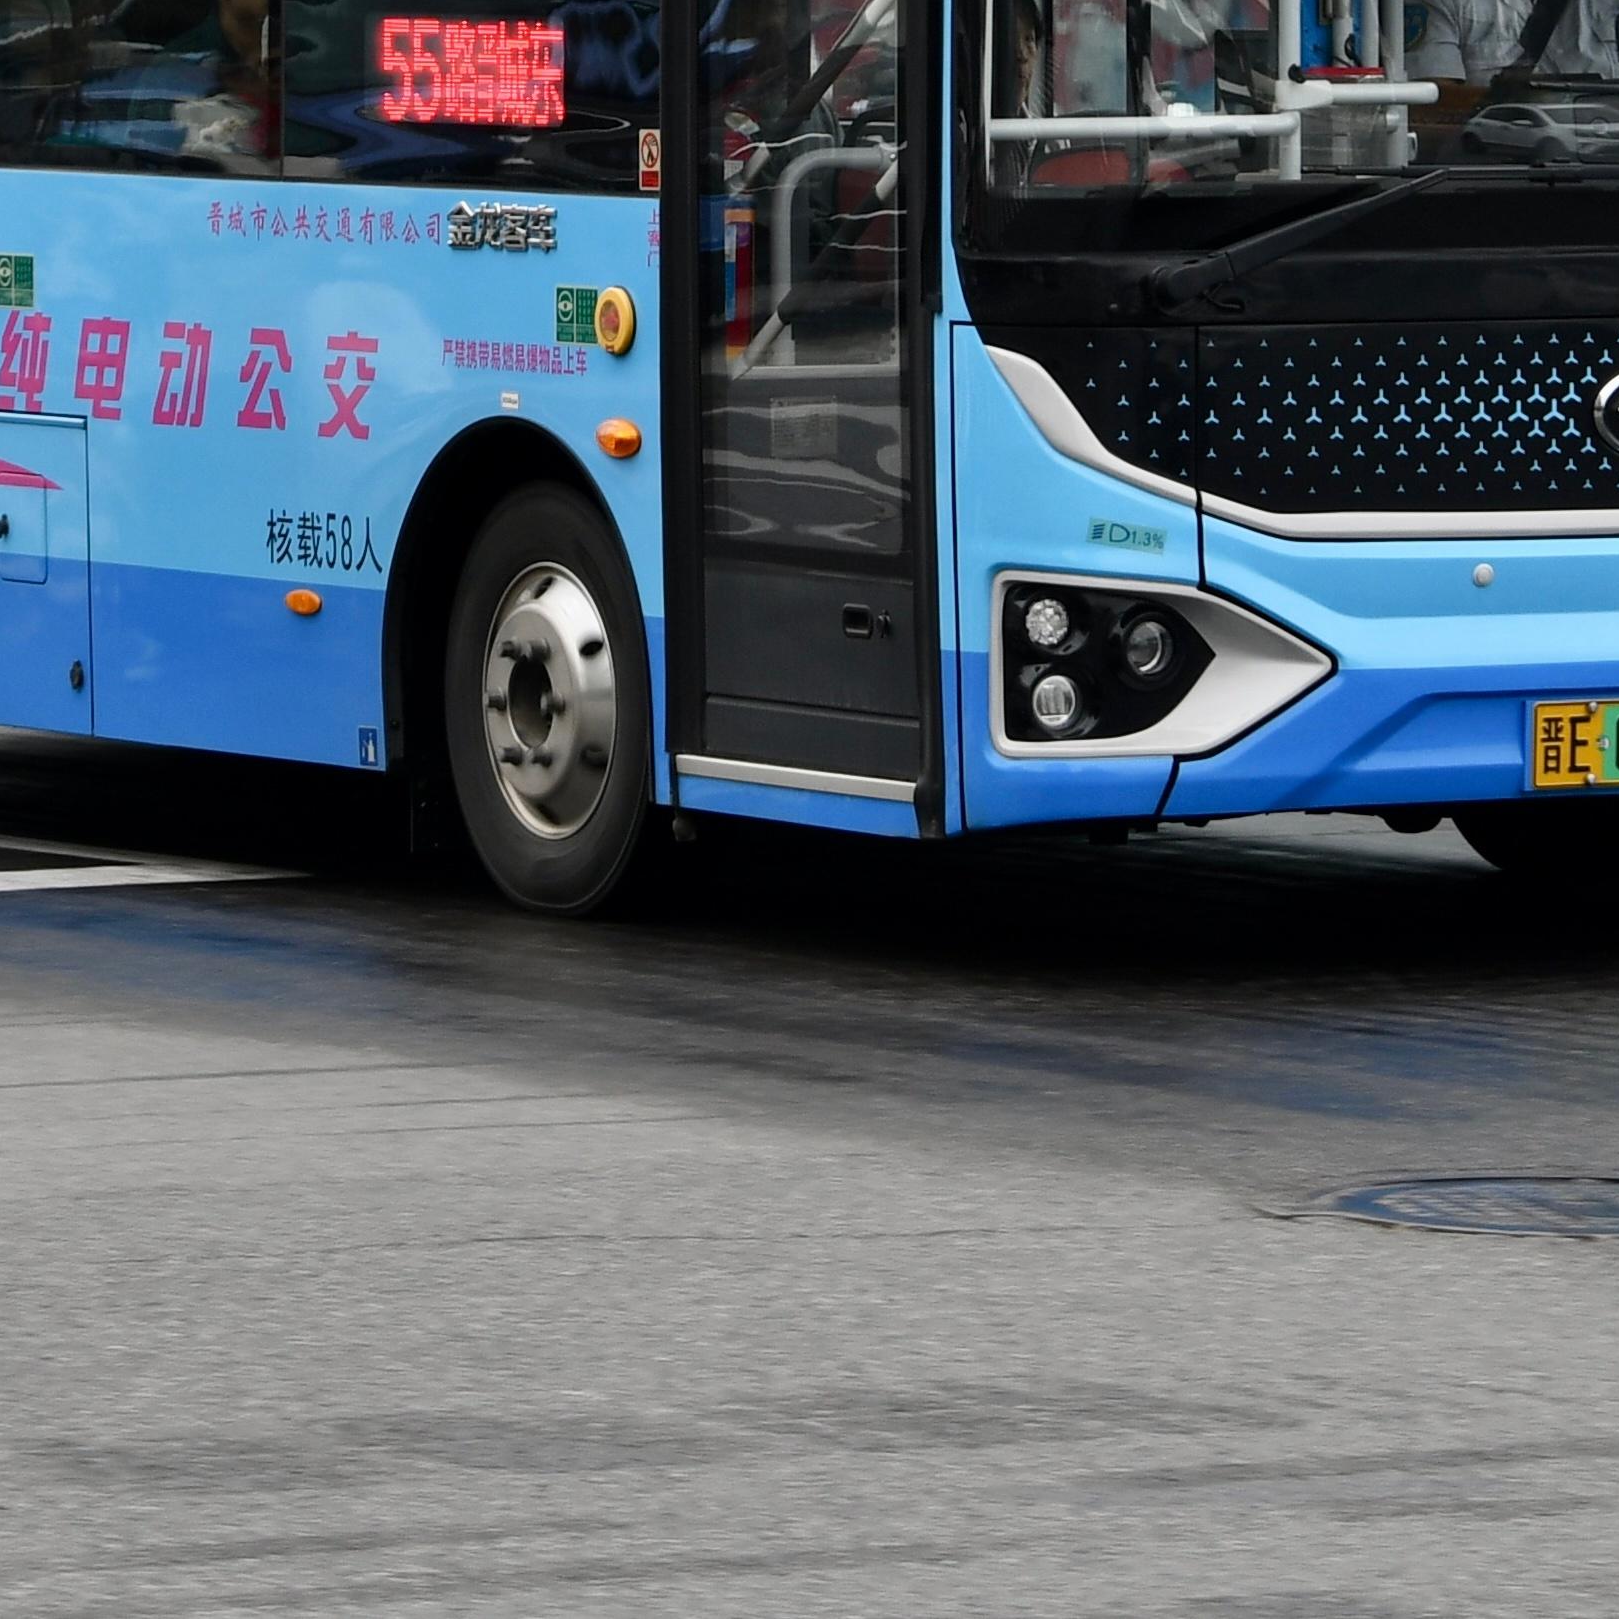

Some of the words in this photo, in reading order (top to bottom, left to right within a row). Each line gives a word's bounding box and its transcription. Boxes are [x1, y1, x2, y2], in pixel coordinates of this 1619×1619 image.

[206, 201, 442, 246] 晋城市公共交通有限公司
[441, 338, 588, 376] 严禁携带易燃易爆物品上车
[266, 507, 383, 574] 核载58人
[1131, 530, 1165, 550] 1.3%
